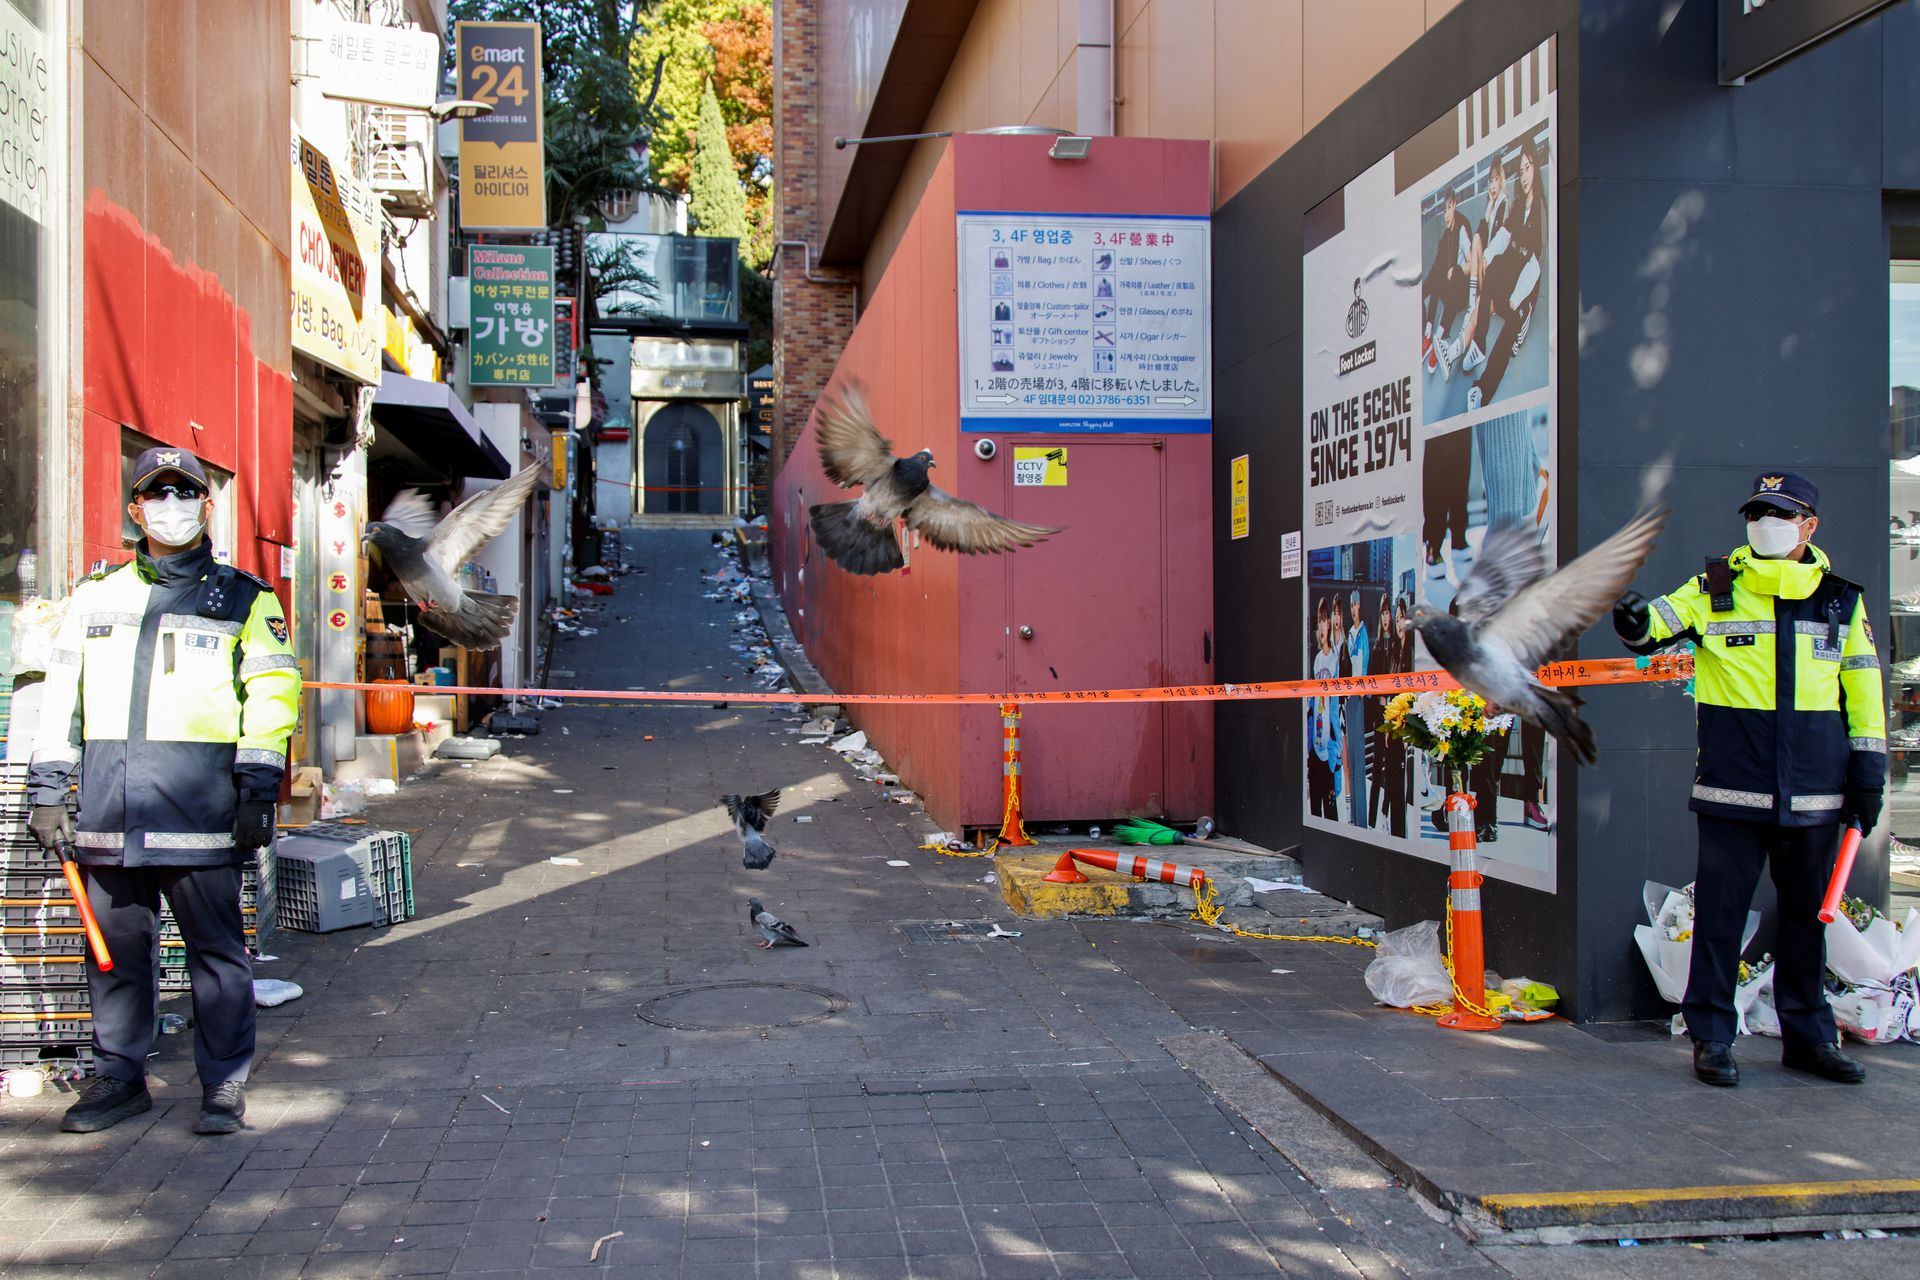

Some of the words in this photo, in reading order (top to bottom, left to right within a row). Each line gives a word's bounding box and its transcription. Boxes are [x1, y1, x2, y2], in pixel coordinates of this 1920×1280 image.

[471, 45, 525, 63] emart
[471, 65, 529, 107] 24
[511, 115, 527, 123] IDEA
[474, 165, 528, 179] 딜리셔스
[474, 182, 529, 196] 아이디어
[1011, 229, 1028, 242] 4F
[1033, 229, 1073, 244] 영업중
[1110, 232, 1126, 244] 4F
[300, 220, 324, 273] CHO
[473, 250, 525, 264] Milano
[1037, 256, 1052, 265] Bag
[474, 267, 548, 281] Collection
[474, 285, 549, 299] 여성구두전문
[1038, 281, 1065, 289] Clothes
[494, 302, 532, 315] 여행용
[475, 317, 549, 347] 가방
[1048, 327, 1063, 335] Gift
[1140, 333, 1158, 342] Cigar
[1049, 353, 1079, 362] Jewelry
[1354, 347, 1375, 367] Locker
[663, 375, 707, 388] Atelier
[1024, 394, 1036, 404] 4F
[1038, 394, 1076, 405] 임대문의
[1311, 407, 1328, 443] ON
[1332, 397, 1359, 436] THE
[1363, 375, 1411, 427] SCENE
[1311, 434, 1359, 487] SINCE
[1364, 416, 1411, 473] 1974
[1016, 462, 1043, 470] CCTV
[1017, 473, 1042, 484] 촬영중
[1815, 651, 1840, 660] POLICE
[1318, 678, 1378, 692] 경찰통제선
[1390, 673, 1439, 688] 경찰서장
